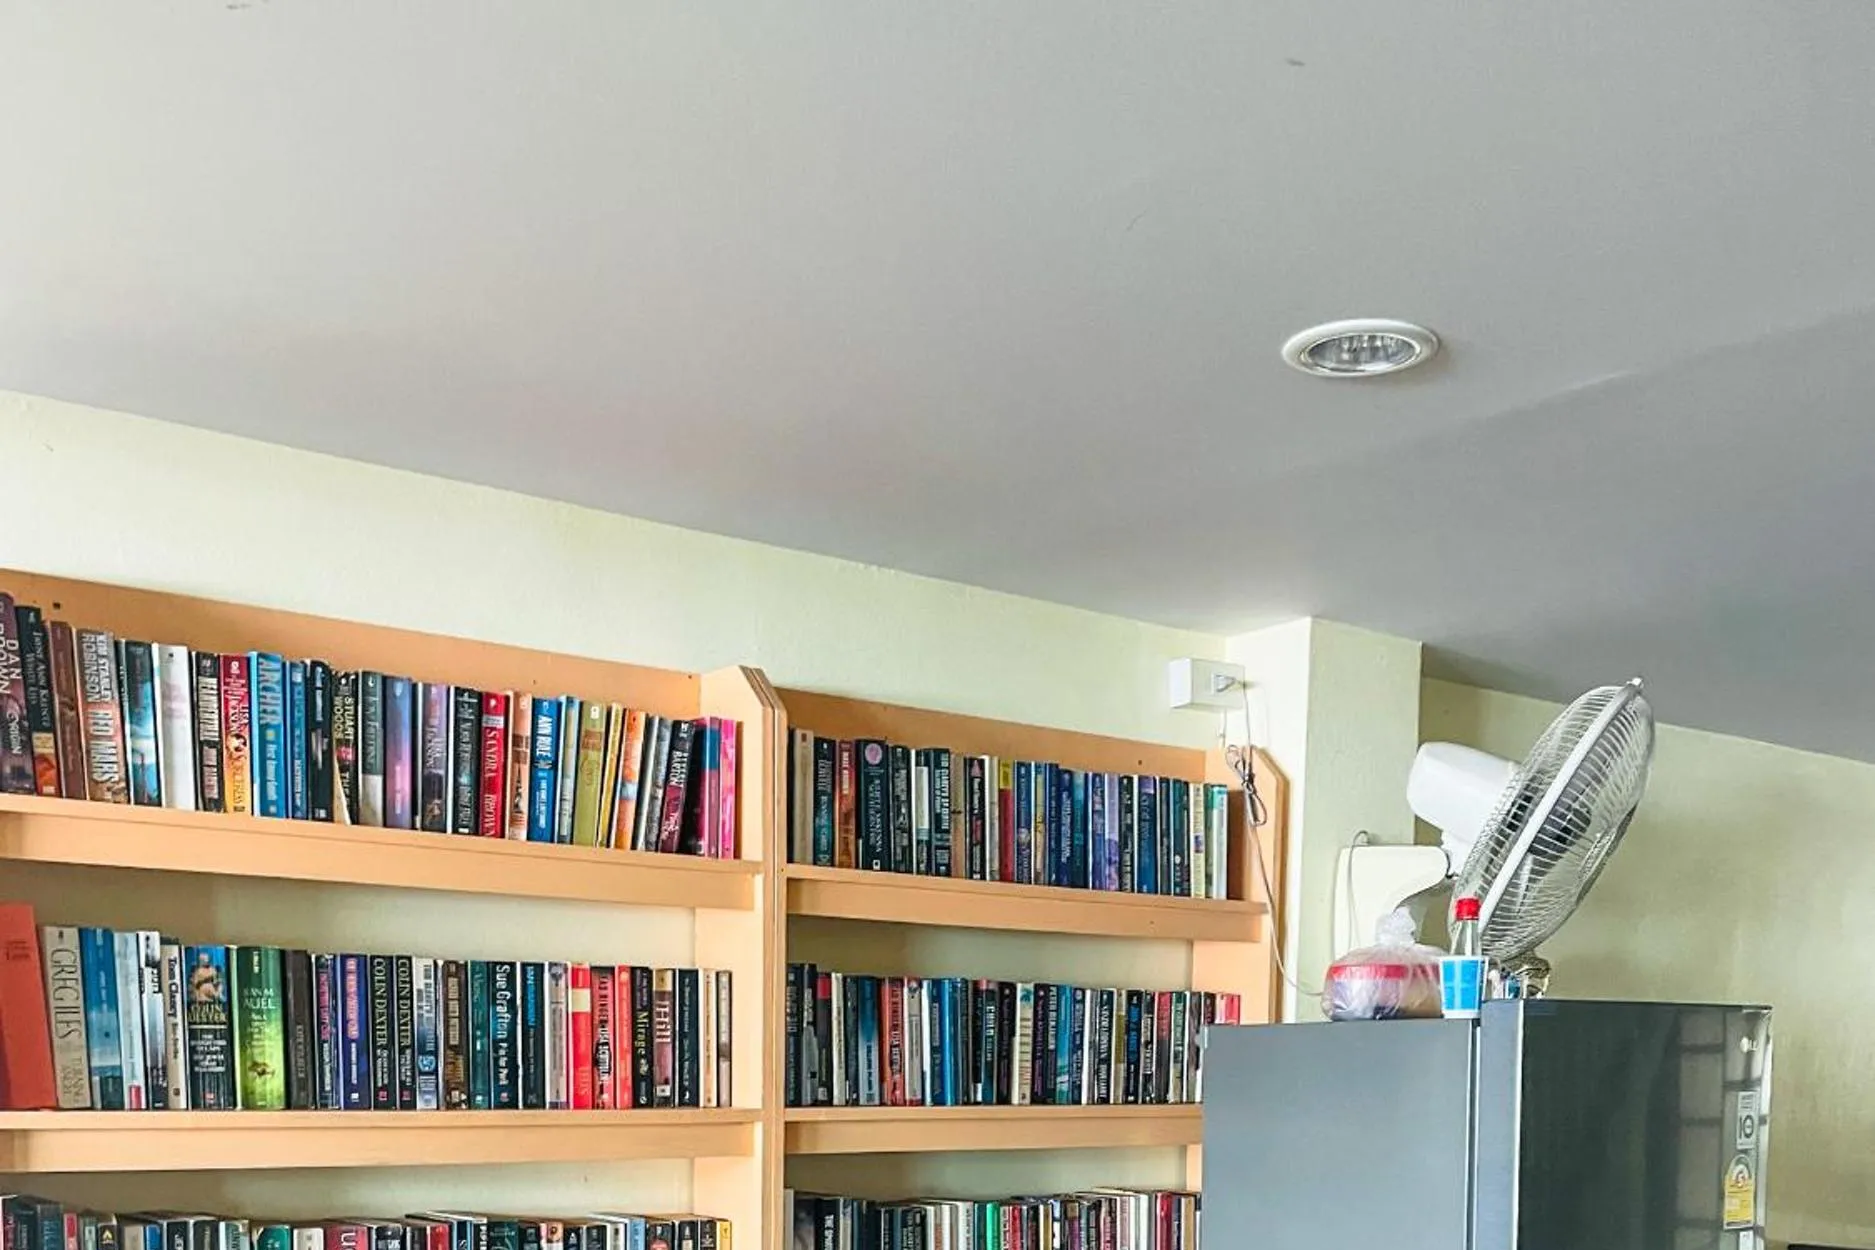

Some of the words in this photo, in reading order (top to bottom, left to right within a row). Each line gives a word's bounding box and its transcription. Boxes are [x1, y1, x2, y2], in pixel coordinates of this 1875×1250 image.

[6, 639, 21, 679] DAN
[82, 633, 103, 702] ROBINSON
[98, 658, 113, 702] STANLEY
[258, 658, 282, 726] ARCHER
[7, 711, 22, 755] ORIGIN
[90, 710, 114, 736] RED
[239, 705, 249, 725] LISA
[334, 696, 344, 740] WOODS
[344, 696, 355, 741] STUART
[536, 715, 553, 736] ANN
[90, 741, 120, 782] MARS
[484, 730, 500, 778] SANDRA
[536, 736, 552, 758] RULE
[669, 751, 683, 786] BARTON
[484, 794, 498, 837] BROWN
[51, 948, 80, 1001] GREG
[168, 957, 179, 981] Tom
[373, 958, 388, 998] COLIN
[397, 959, 409, 997] COLIN
[496, 964, 511, 989] Sue
[167, 982, 180, 1019] Clancy
[496, 990, 512, 1039] Grafton
[54, 1006, 83, 1040] ILES
[374, 999, 388, 1046] DEXTER
[398, 999, 411, 1047] DEXTER
[635, 1010, 650, 1054] Mirage
[655, 1006, 672, 1043] Hill
